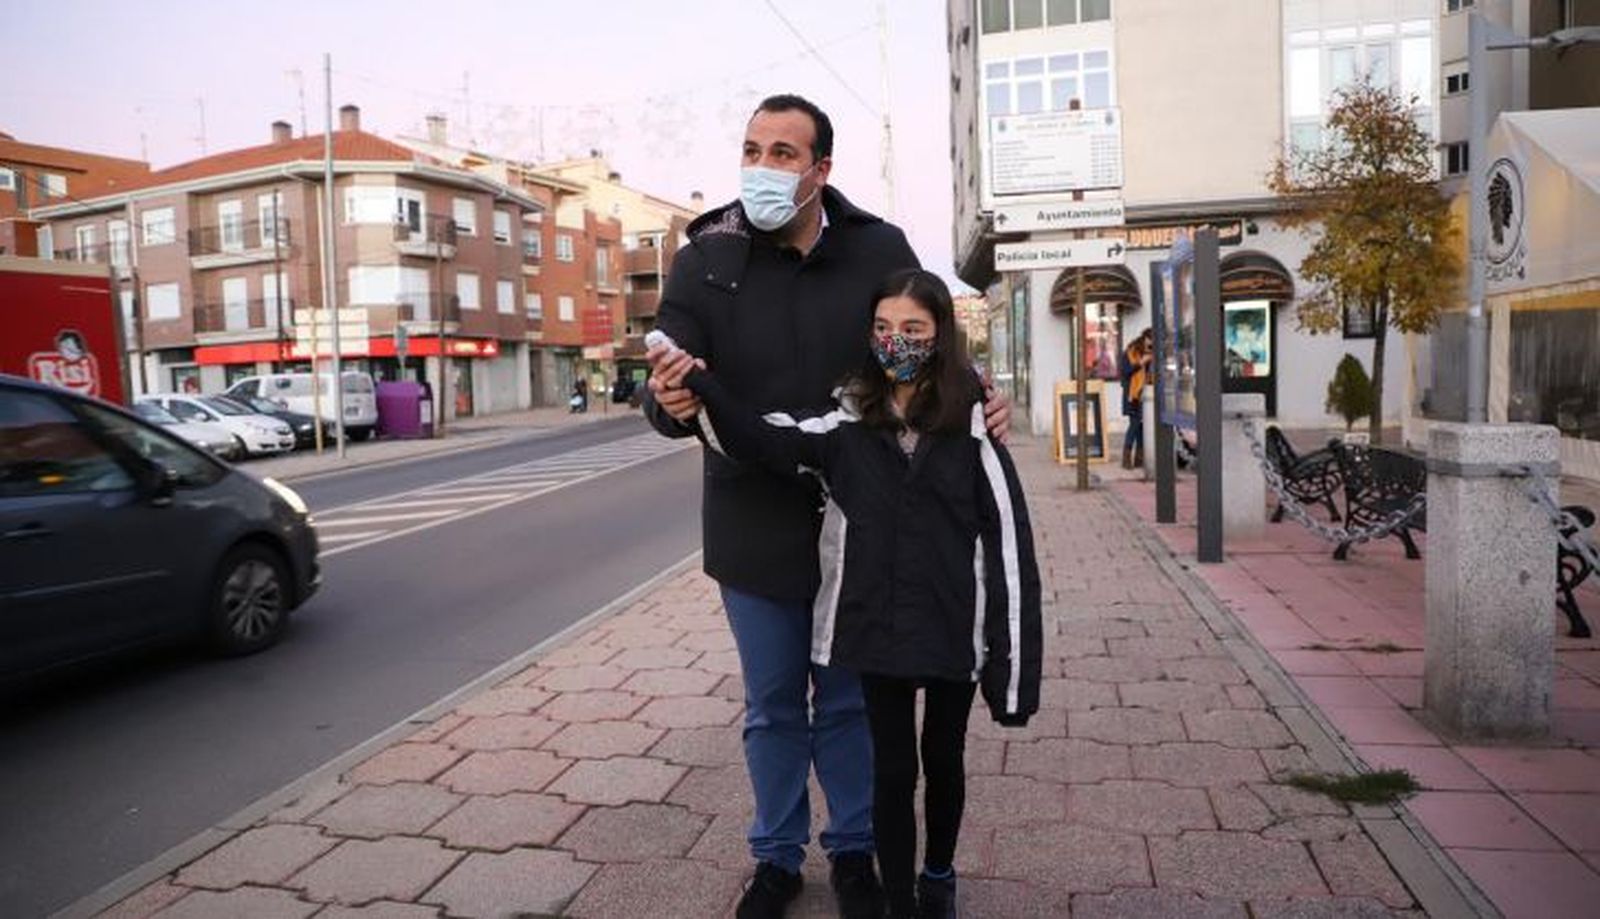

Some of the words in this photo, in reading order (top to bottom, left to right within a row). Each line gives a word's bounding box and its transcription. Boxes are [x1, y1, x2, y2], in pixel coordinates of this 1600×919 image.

[1037, 206, 1122, 222] Ayuntamiento
[1041, 248, 1072, 260] local
[35, 360, 90, 389] Risi
